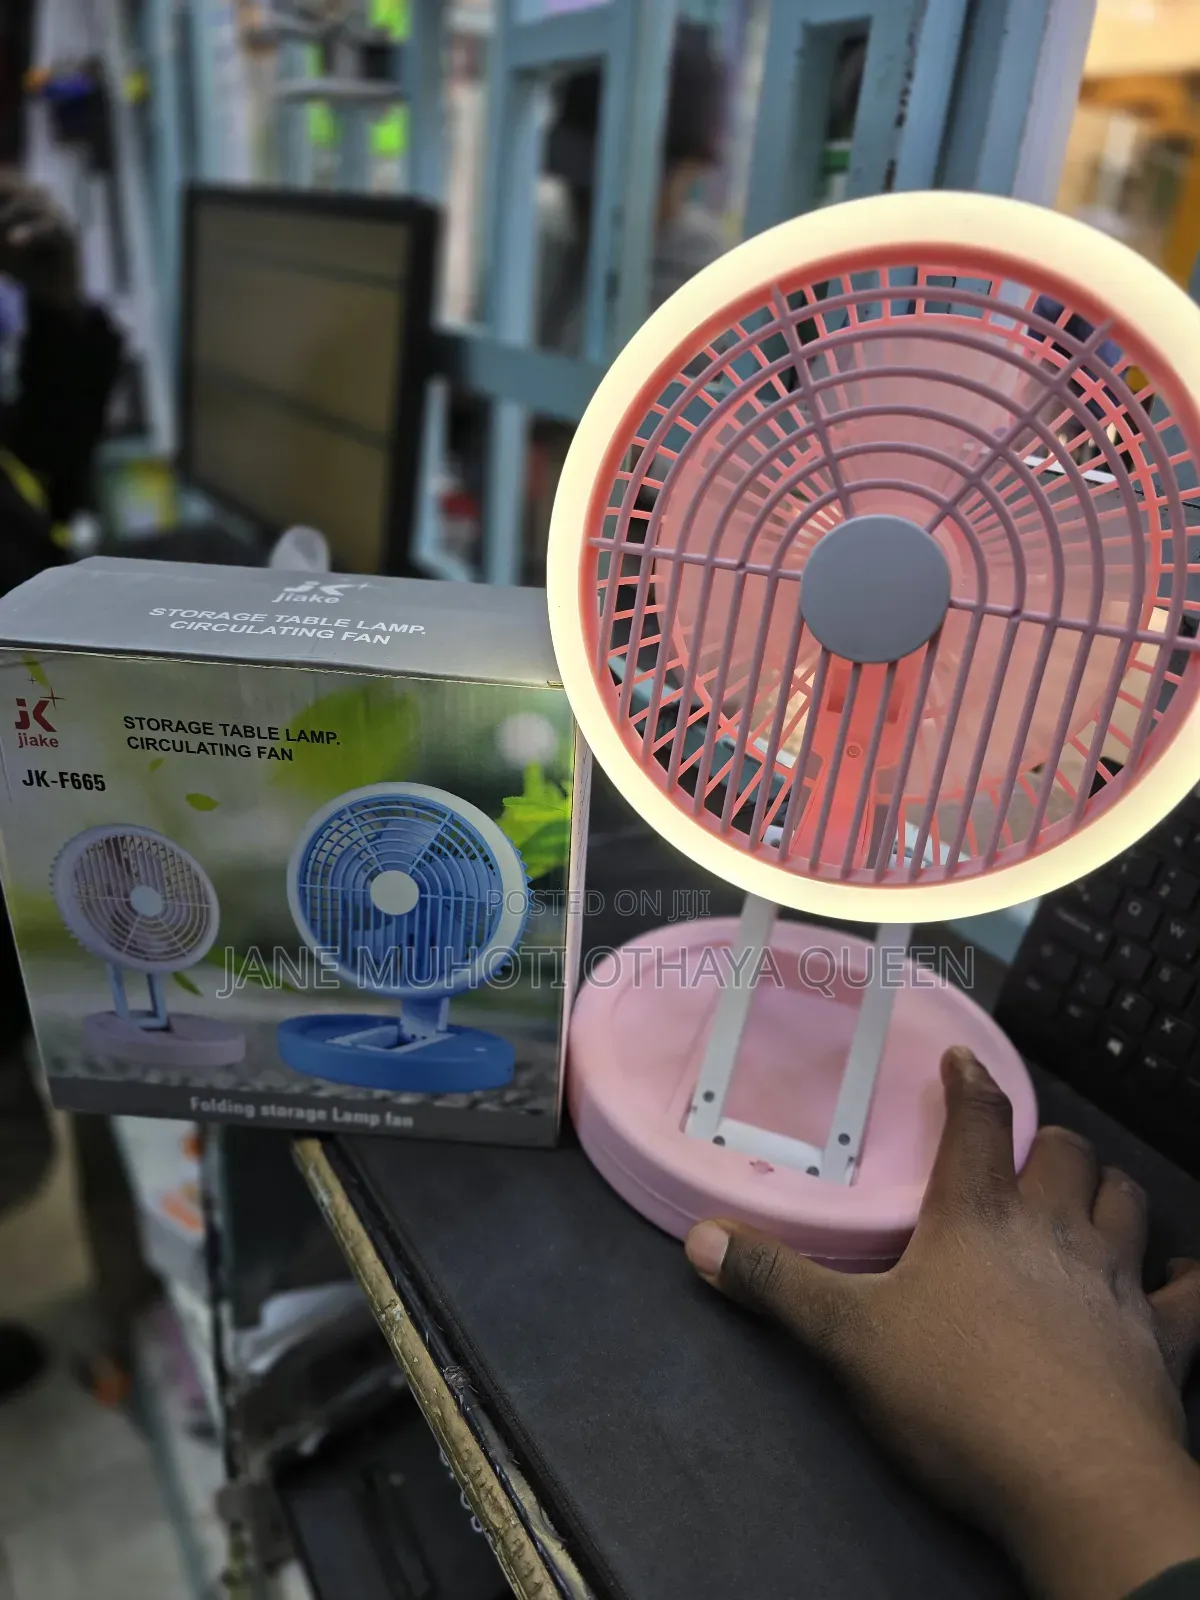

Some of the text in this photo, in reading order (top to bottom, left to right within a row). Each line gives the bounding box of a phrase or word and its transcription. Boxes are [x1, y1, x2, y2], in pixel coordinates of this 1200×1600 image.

[272, 592, 340, 604] jiake
[149, 607, 426, 635] STORAGE TABLE LAMP.
[169, 620, 391, 645] CIRCULATING FAN
[17, 732, 60, 749] jiake
[123, 715, 341, 745] STORAGE TABLE LAMP.
[126, 735, 294, 762] CIRCULATING FAN
[21, 769, 107, 792] JK-F665
[190, 1096, 414, 1127] Folding storage Lamp fan
